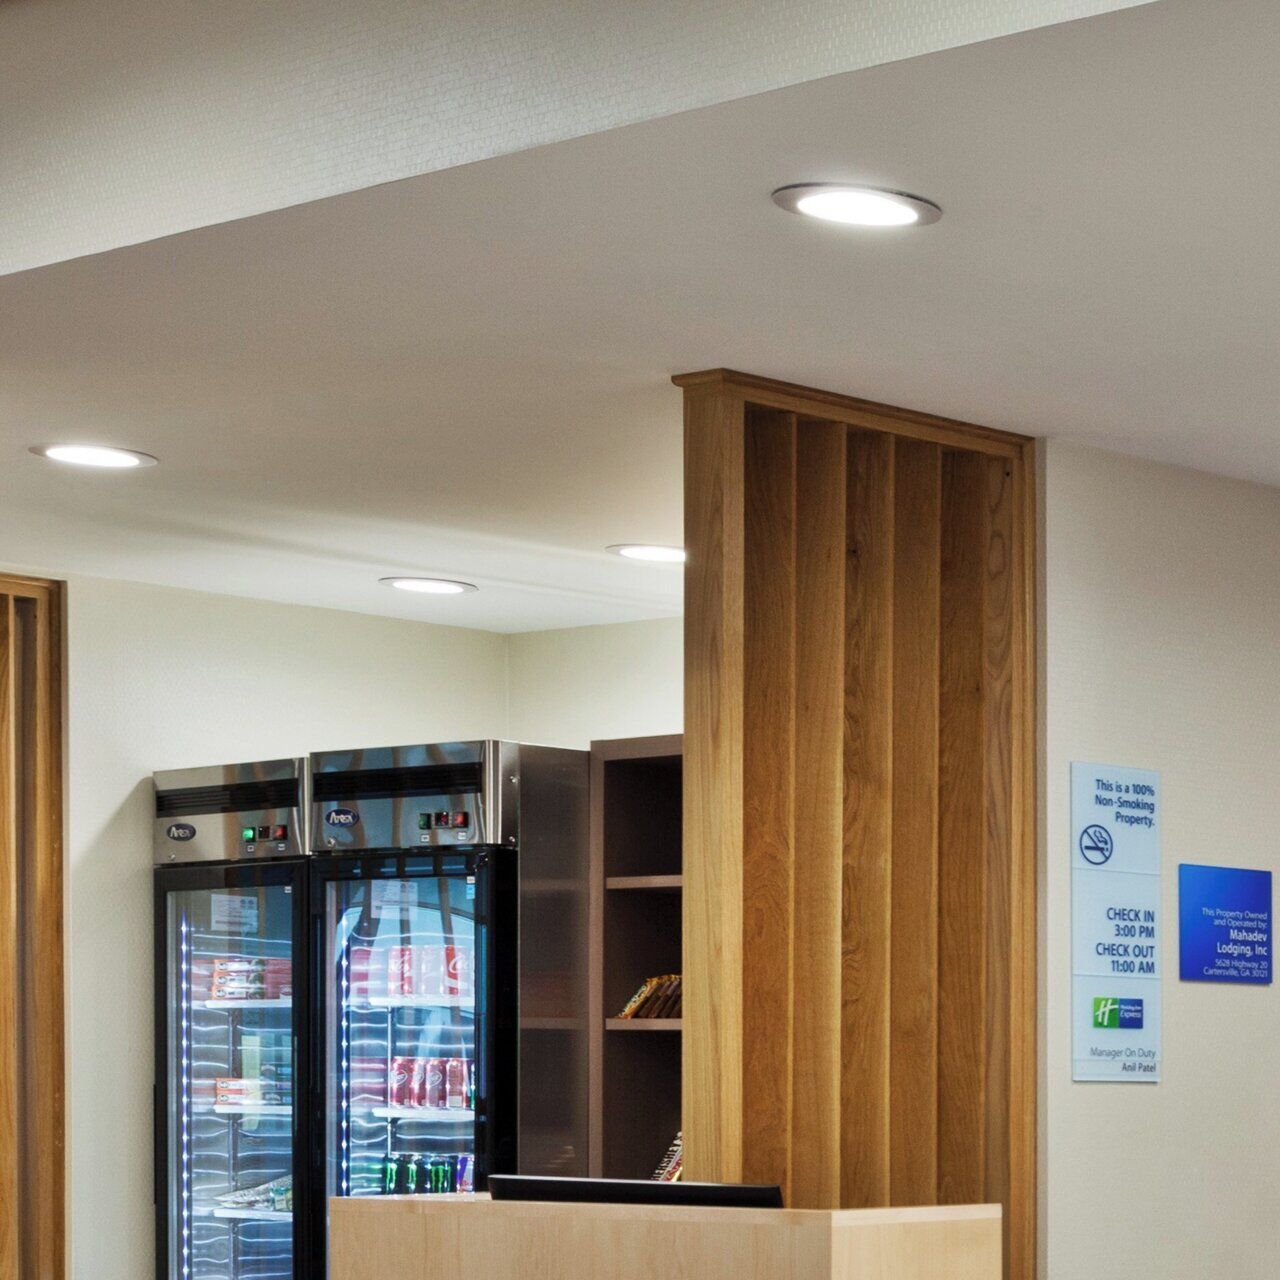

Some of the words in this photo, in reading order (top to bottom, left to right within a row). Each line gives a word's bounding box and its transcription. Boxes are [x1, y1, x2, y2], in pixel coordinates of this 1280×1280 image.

[1096, 779, 1113, 791] This
[1115, 781, 1122, 792] is
[1125, 785, 1130, 793] a
[1132, 784, 1155, 796] 100%
[1115, 811, 1155, 828] Property.
[1107, 907, 1141, 922] CHECK
[1144, 910, 1155, 922] IN
[1202, 907, 1215, 917] This
[1216, 909, 1243, 920] Property
[1244, 911, 1268, 920] Owned
[1227, 919, 1257, 928] Operated
[1114, 924, 1136, 937] 3:00
[1139, 925, 1155, 938] PM
[1230, 929, 1268, 942] Mahadev
[1096, 942, 1130, 957] CHECK
[1133, 944, 1155, 958] OUT
[1217, 942, 1253, 957] Lodging,
[1255, 944, 1268, 956] Inc
[1111, 960, 1135, 973] 11:00
[1138, 961, 1155, 974] AM
[1231, 960, 1258, 969] Highway
[1241, 969, 1250, 977] GA
[1090, 1047, 1123, 1060] Manager
[1125, 1047, 1136, 1057] On
[1137, 1048, 1156, 1059] Duty
[1122, 1062, 1136, 1072] Anil
[1138, 1063, 1156, 1073] Patel
